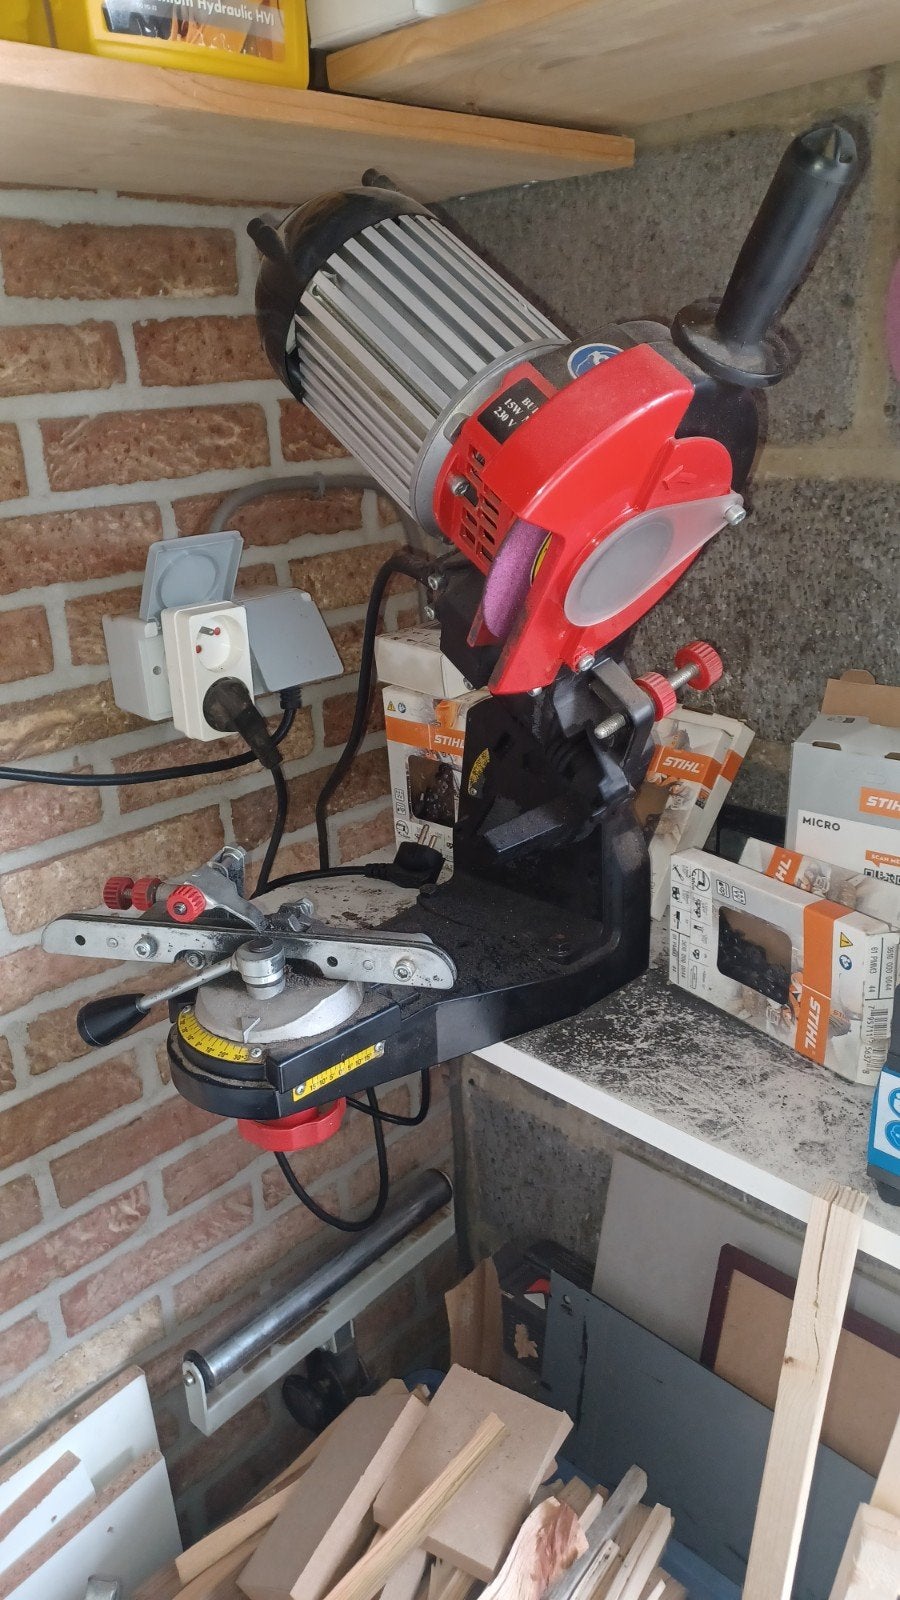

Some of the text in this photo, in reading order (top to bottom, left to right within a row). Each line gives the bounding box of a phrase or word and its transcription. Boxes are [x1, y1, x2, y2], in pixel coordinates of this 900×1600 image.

[197, 0, 253, 21] Hydraulic
[256, 10, 275, 26] HVI
[504, 398, 524, 415] 15W
[493, 406, 510, 422] 230
[508, 418, 517, 427] V
[662, 756, 700, 774] STIHL
[802, 816, 841, 831] MICRO
[804, 996, 821, 1049] STIHL
